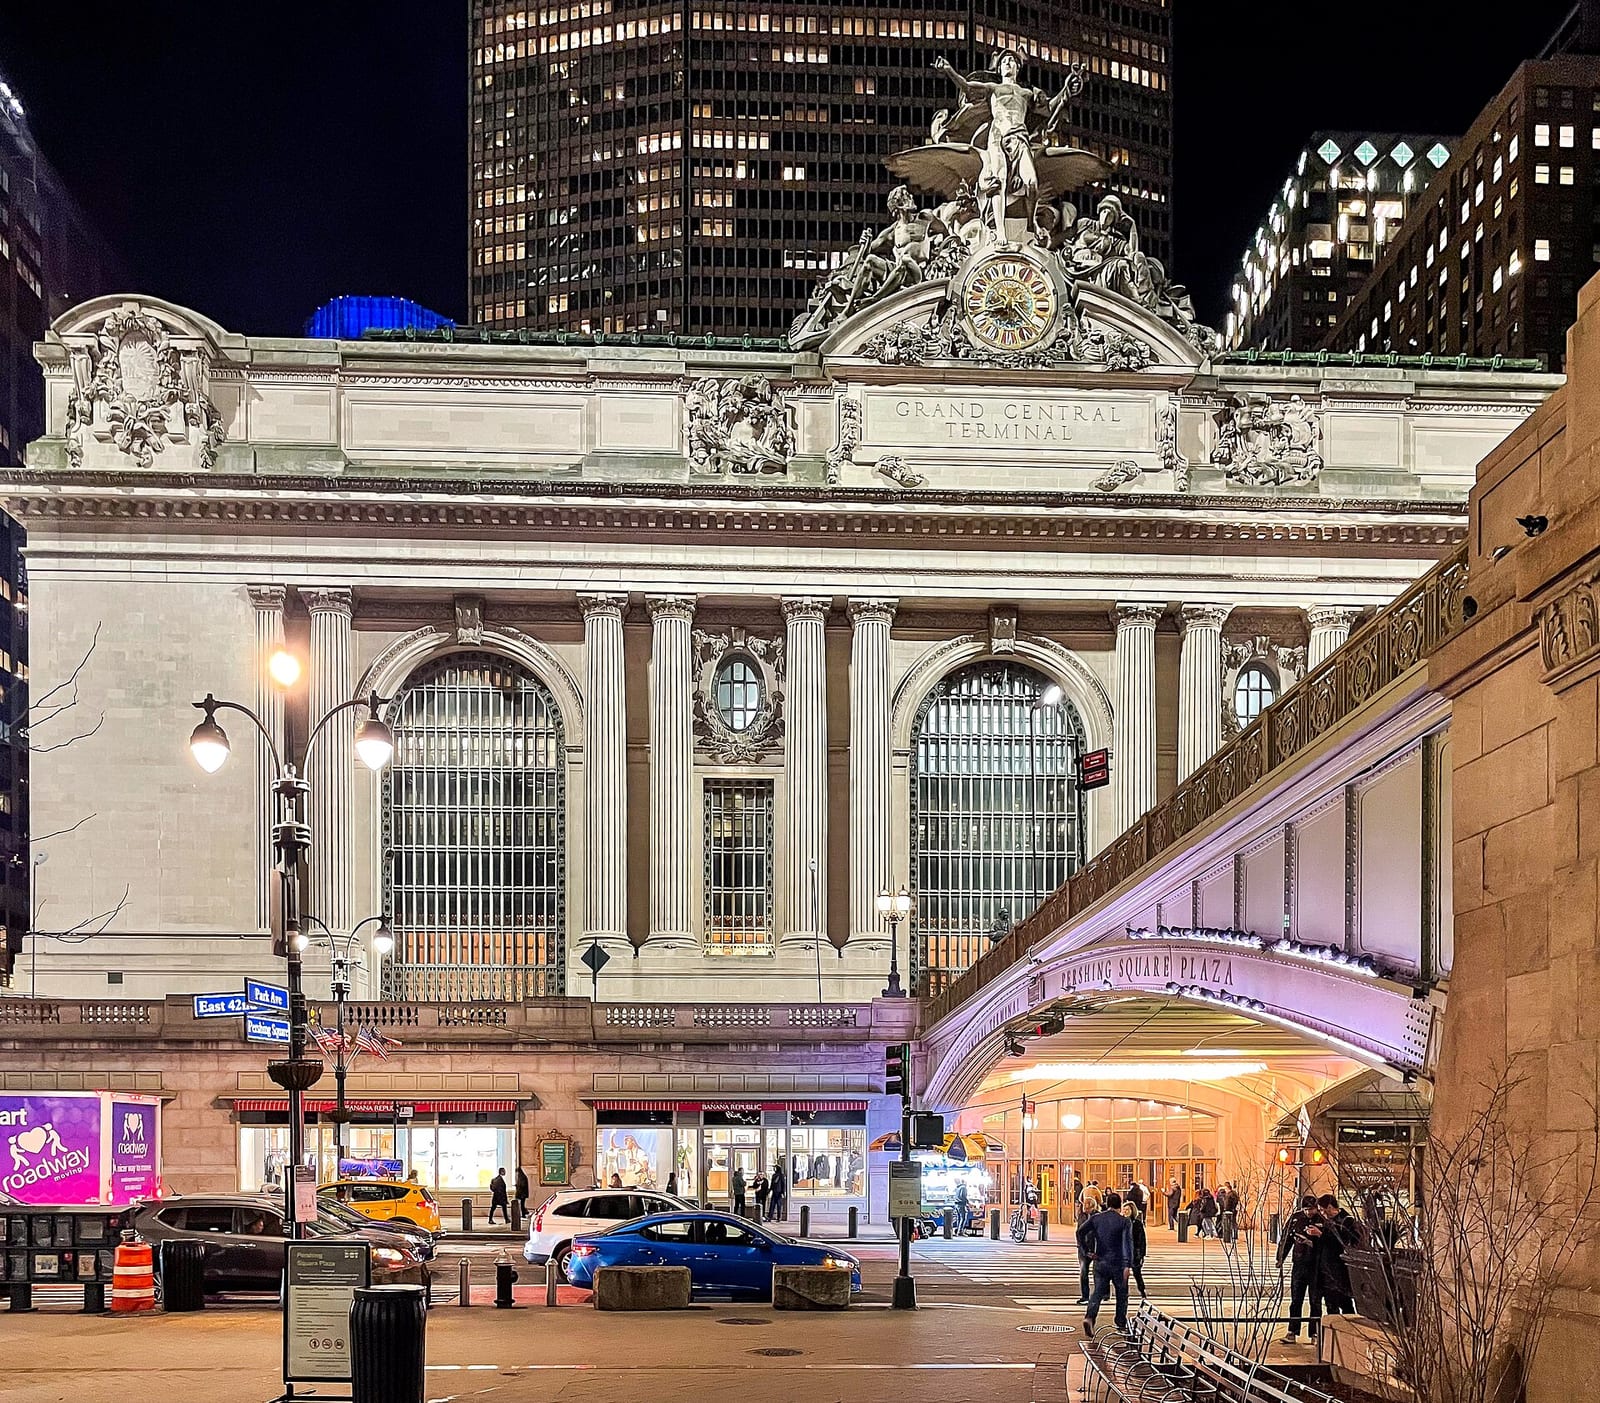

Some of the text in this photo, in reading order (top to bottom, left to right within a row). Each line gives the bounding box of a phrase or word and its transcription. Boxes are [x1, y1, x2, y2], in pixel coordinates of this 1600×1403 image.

[895, 401, 1122, 423] GRAND CENTRAL
[945, 422, 1073, 441] TERMINAL
[1060, 955, 1234, 987] PERSHING SQUARE PLAZA
[254, 987, 283, 1005] Park Ave
[198, 1000, 226, 1013] East
[118, 1140, 148, 1158] roadway
[2, 1146, 90, 1193] roadway
[53, 1167, 83, 1182] moving
